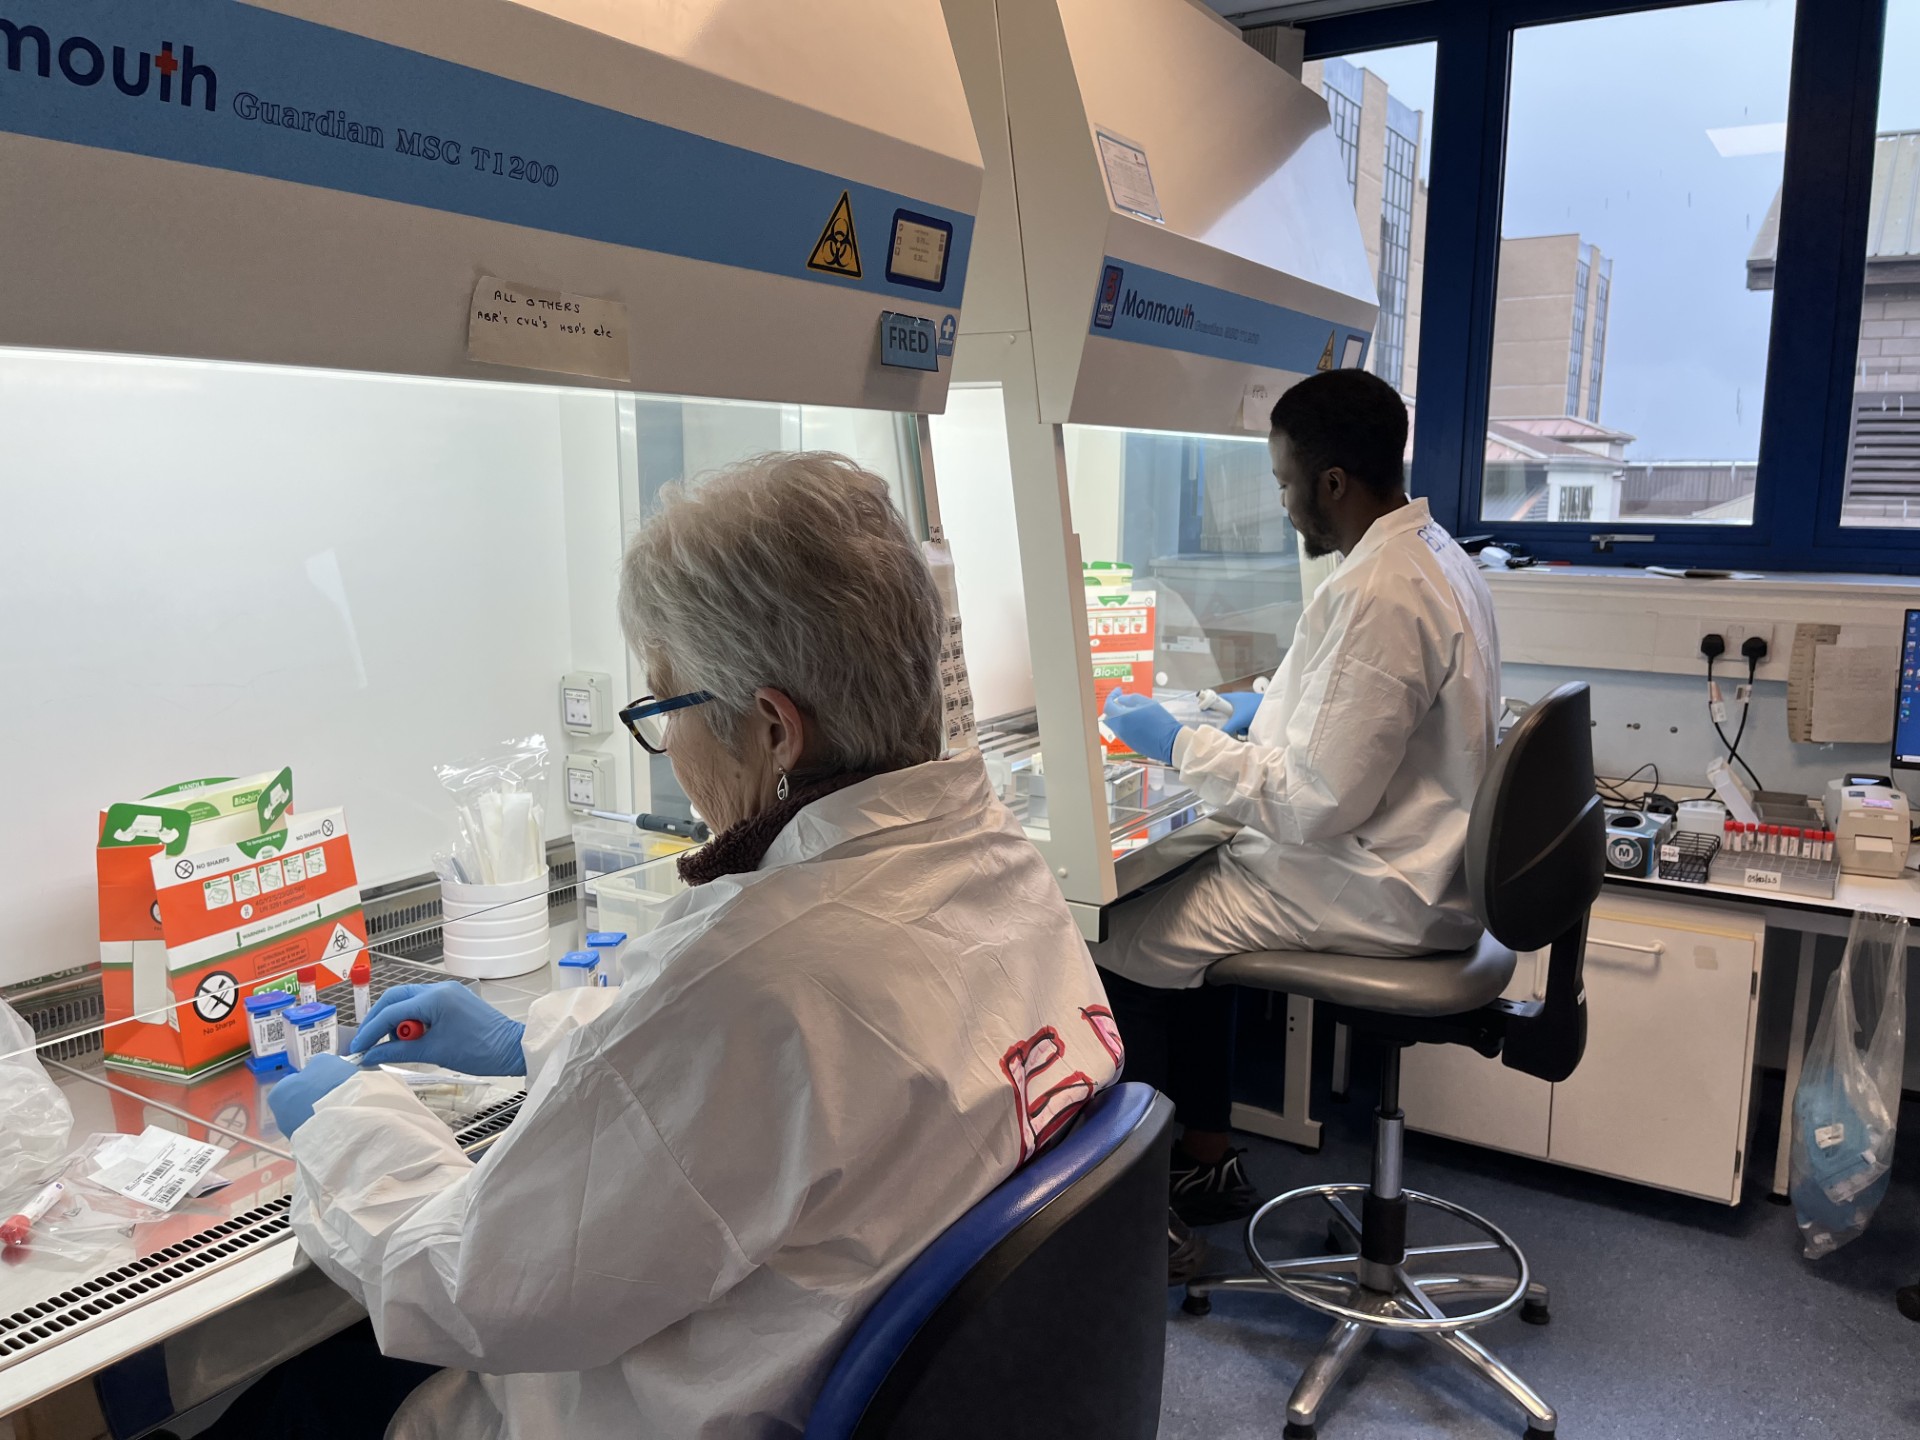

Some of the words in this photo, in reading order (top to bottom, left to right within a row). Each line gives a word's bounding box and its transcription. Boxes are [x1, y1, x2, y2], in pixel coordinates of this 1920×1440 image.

[233, 91, 384, 149] Guardian
[396, 128, 461, 166] MSC
[471, 146, 559, 188] T1200
[494, 290, 516, 303] ALL
[526, 299, 580, 314] OTHERS
[1099, 302, 1114, 313] year
[1121, 289, 1195, 330] Monmouth
[593, 325, 613, 338] etc
[889, 326, 929, 354] FRED
[303, 829, 321, 840] SHARPS
[1619, 847, 1630, 858] M
[206, 857, 230, 868] SHARPS
[342, 969, 347, 979] 6
[203, 1028, 214, 1036] No
[215, 1019, 236, 1032] Sharps
